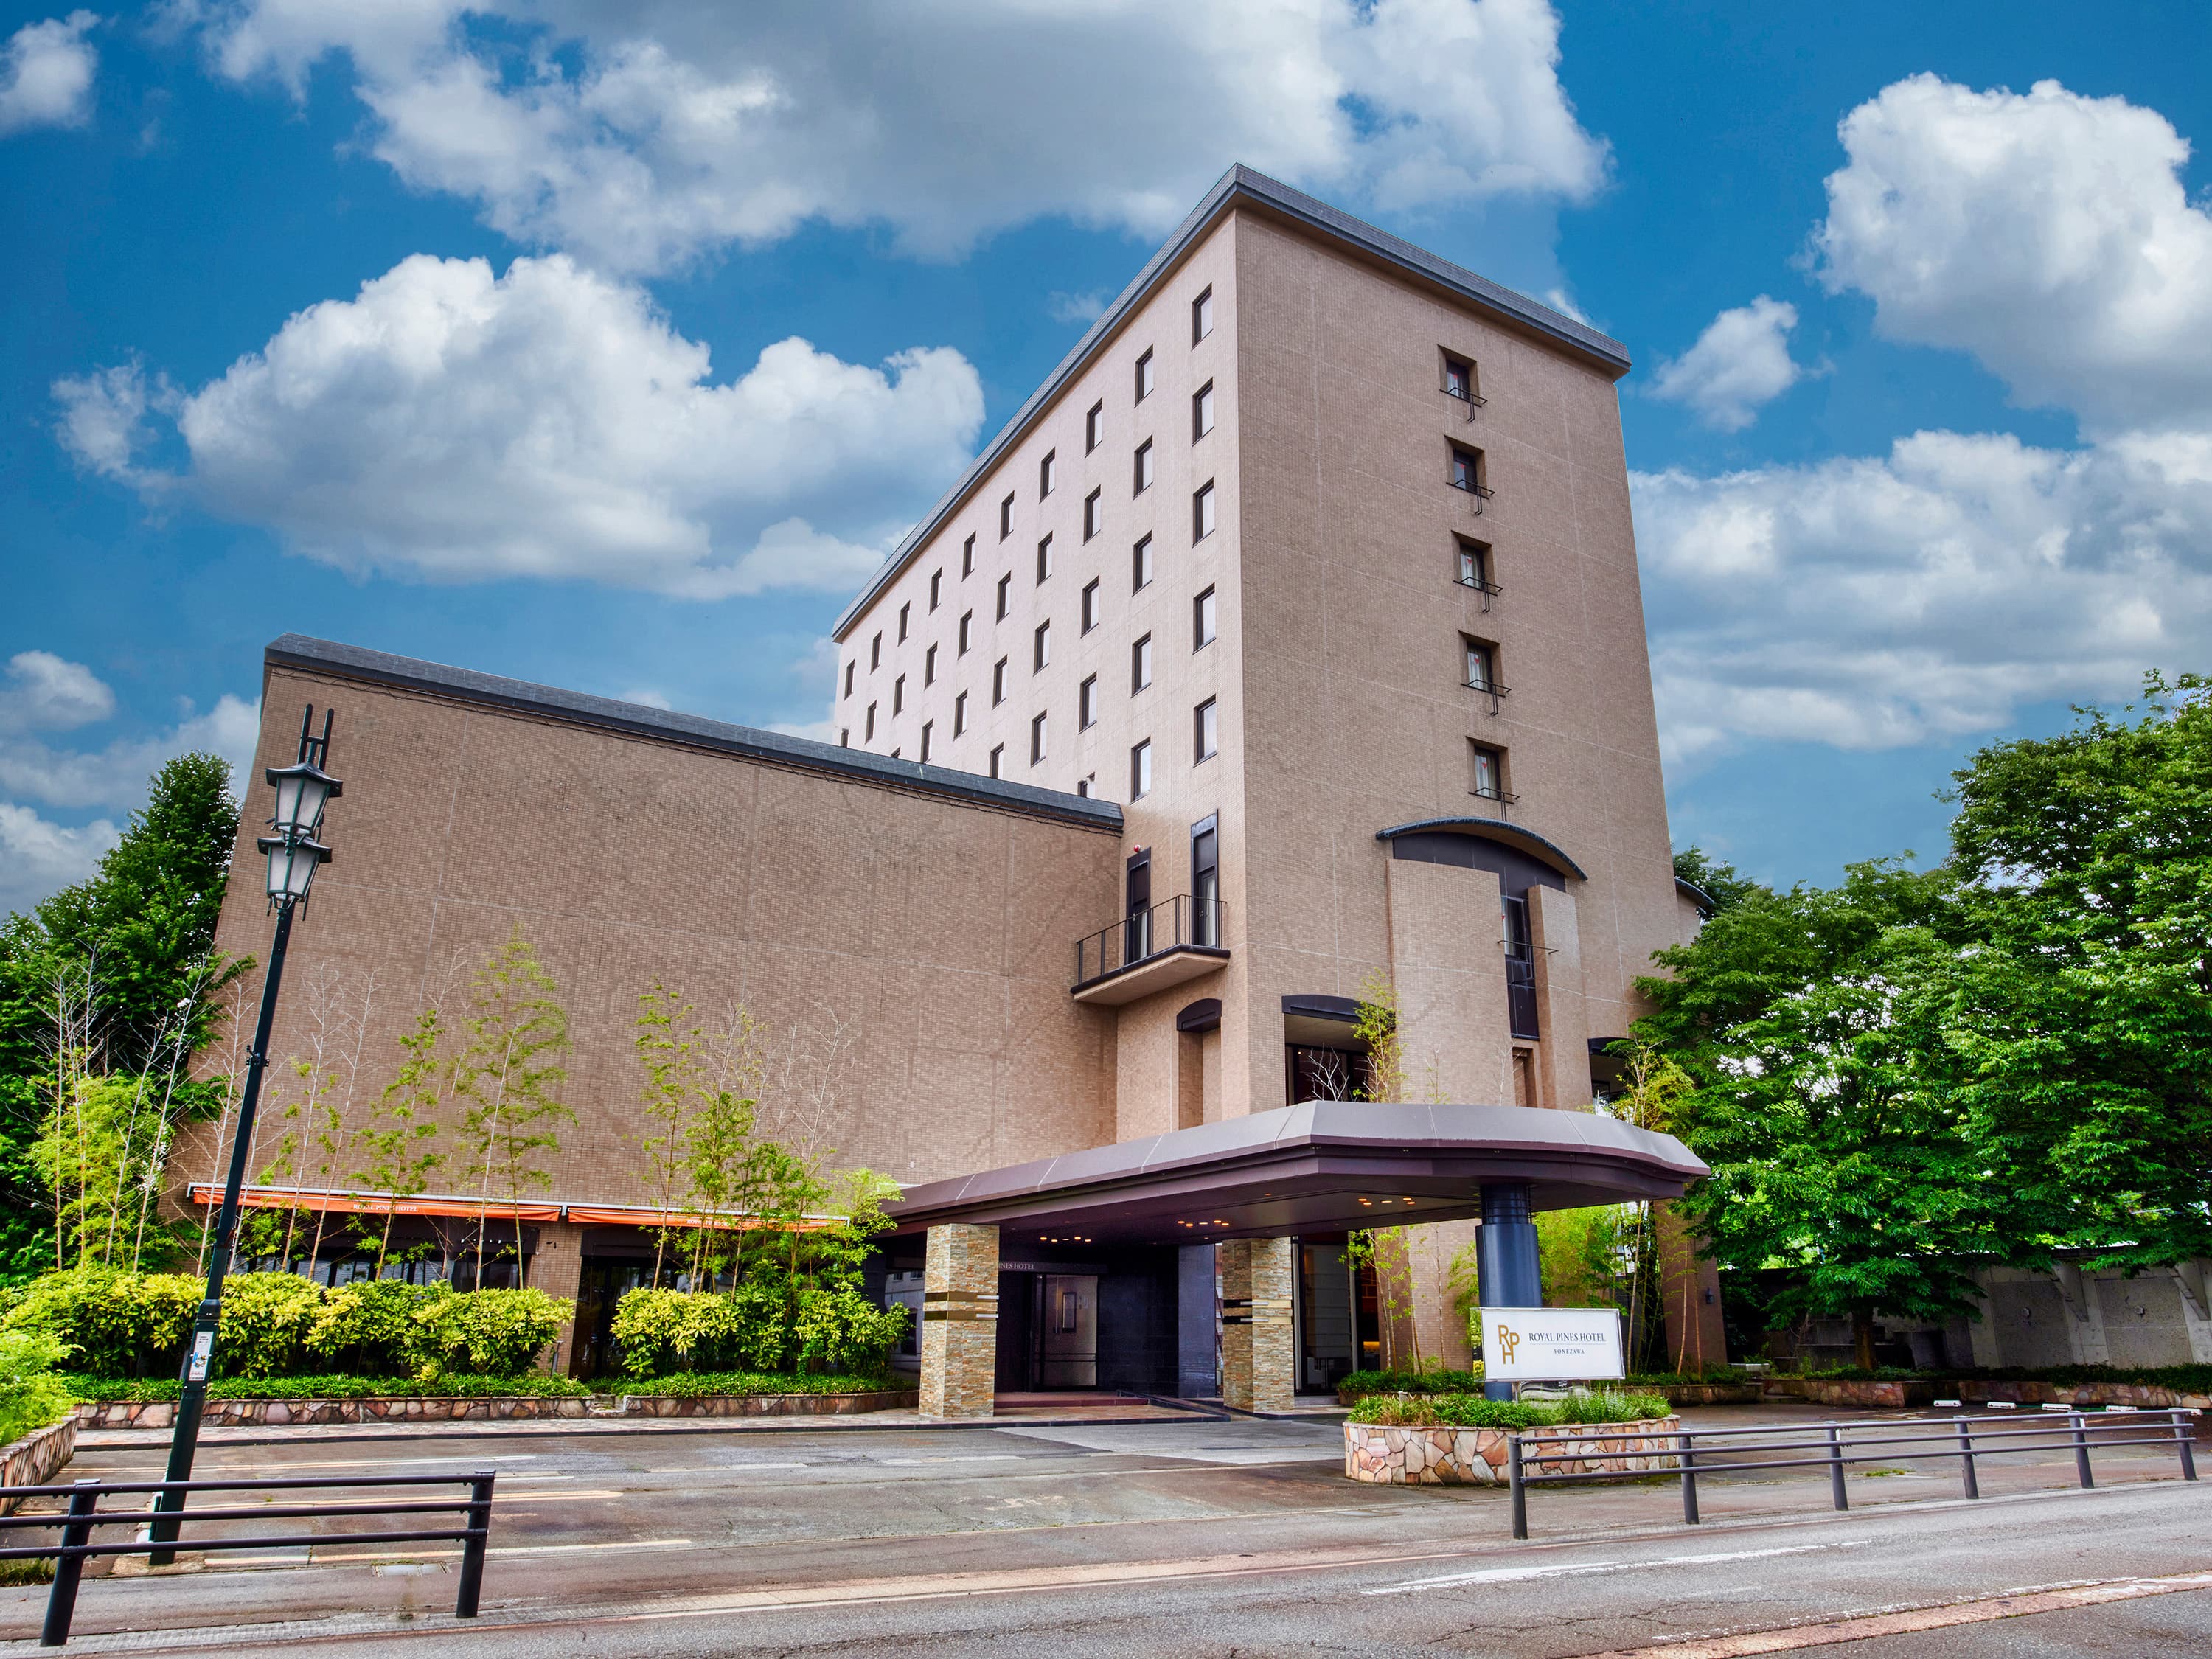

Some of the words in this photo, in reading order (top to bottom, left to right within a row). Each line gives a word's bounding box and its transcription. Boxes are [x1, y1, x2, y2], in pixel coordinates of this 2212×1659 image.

[1528, 1332, 1555, 1342] ROYAL
[1556, 1332, 1579, 1342] PINES
[1579, 1332, 1607, 1342] HOTEL
